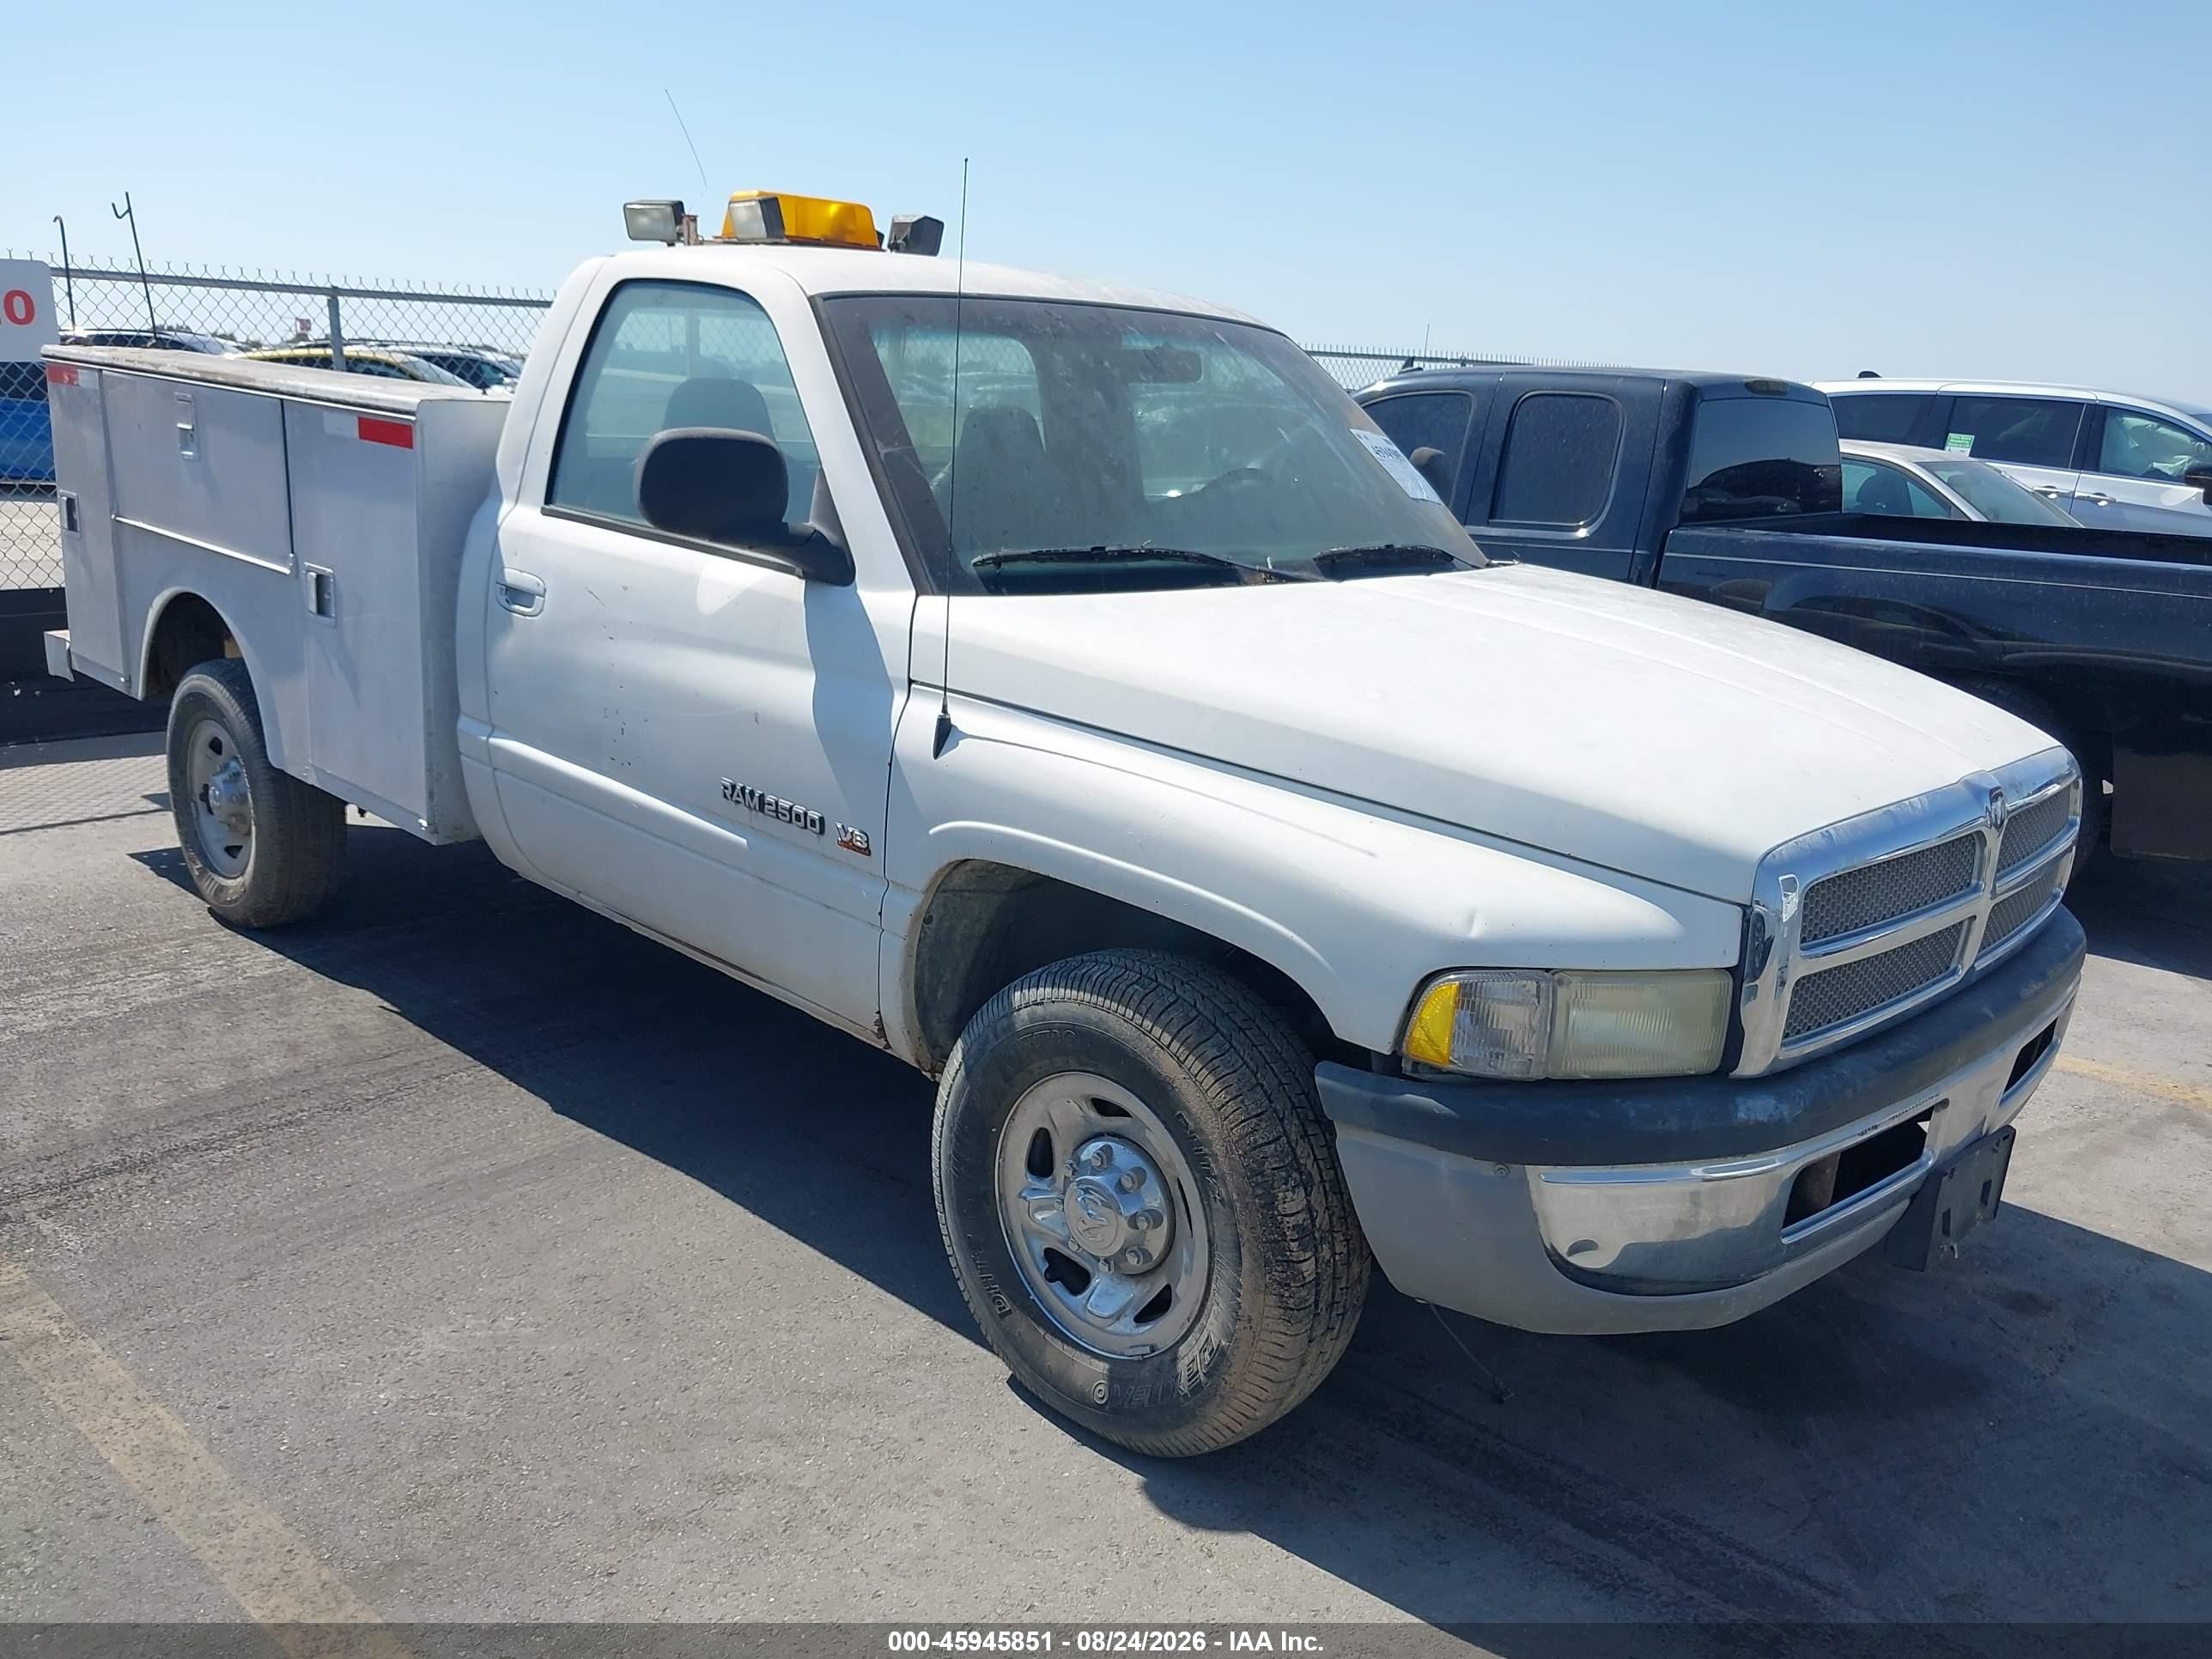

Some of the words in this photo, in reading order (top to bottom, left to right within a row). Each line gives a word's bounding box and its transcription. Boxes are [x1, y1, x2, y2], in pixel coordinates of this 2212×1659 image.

[720, 776, 765, 813] RAM
[763, 794, 826, 836] 2500
[835, 821, 871, 850] V8
